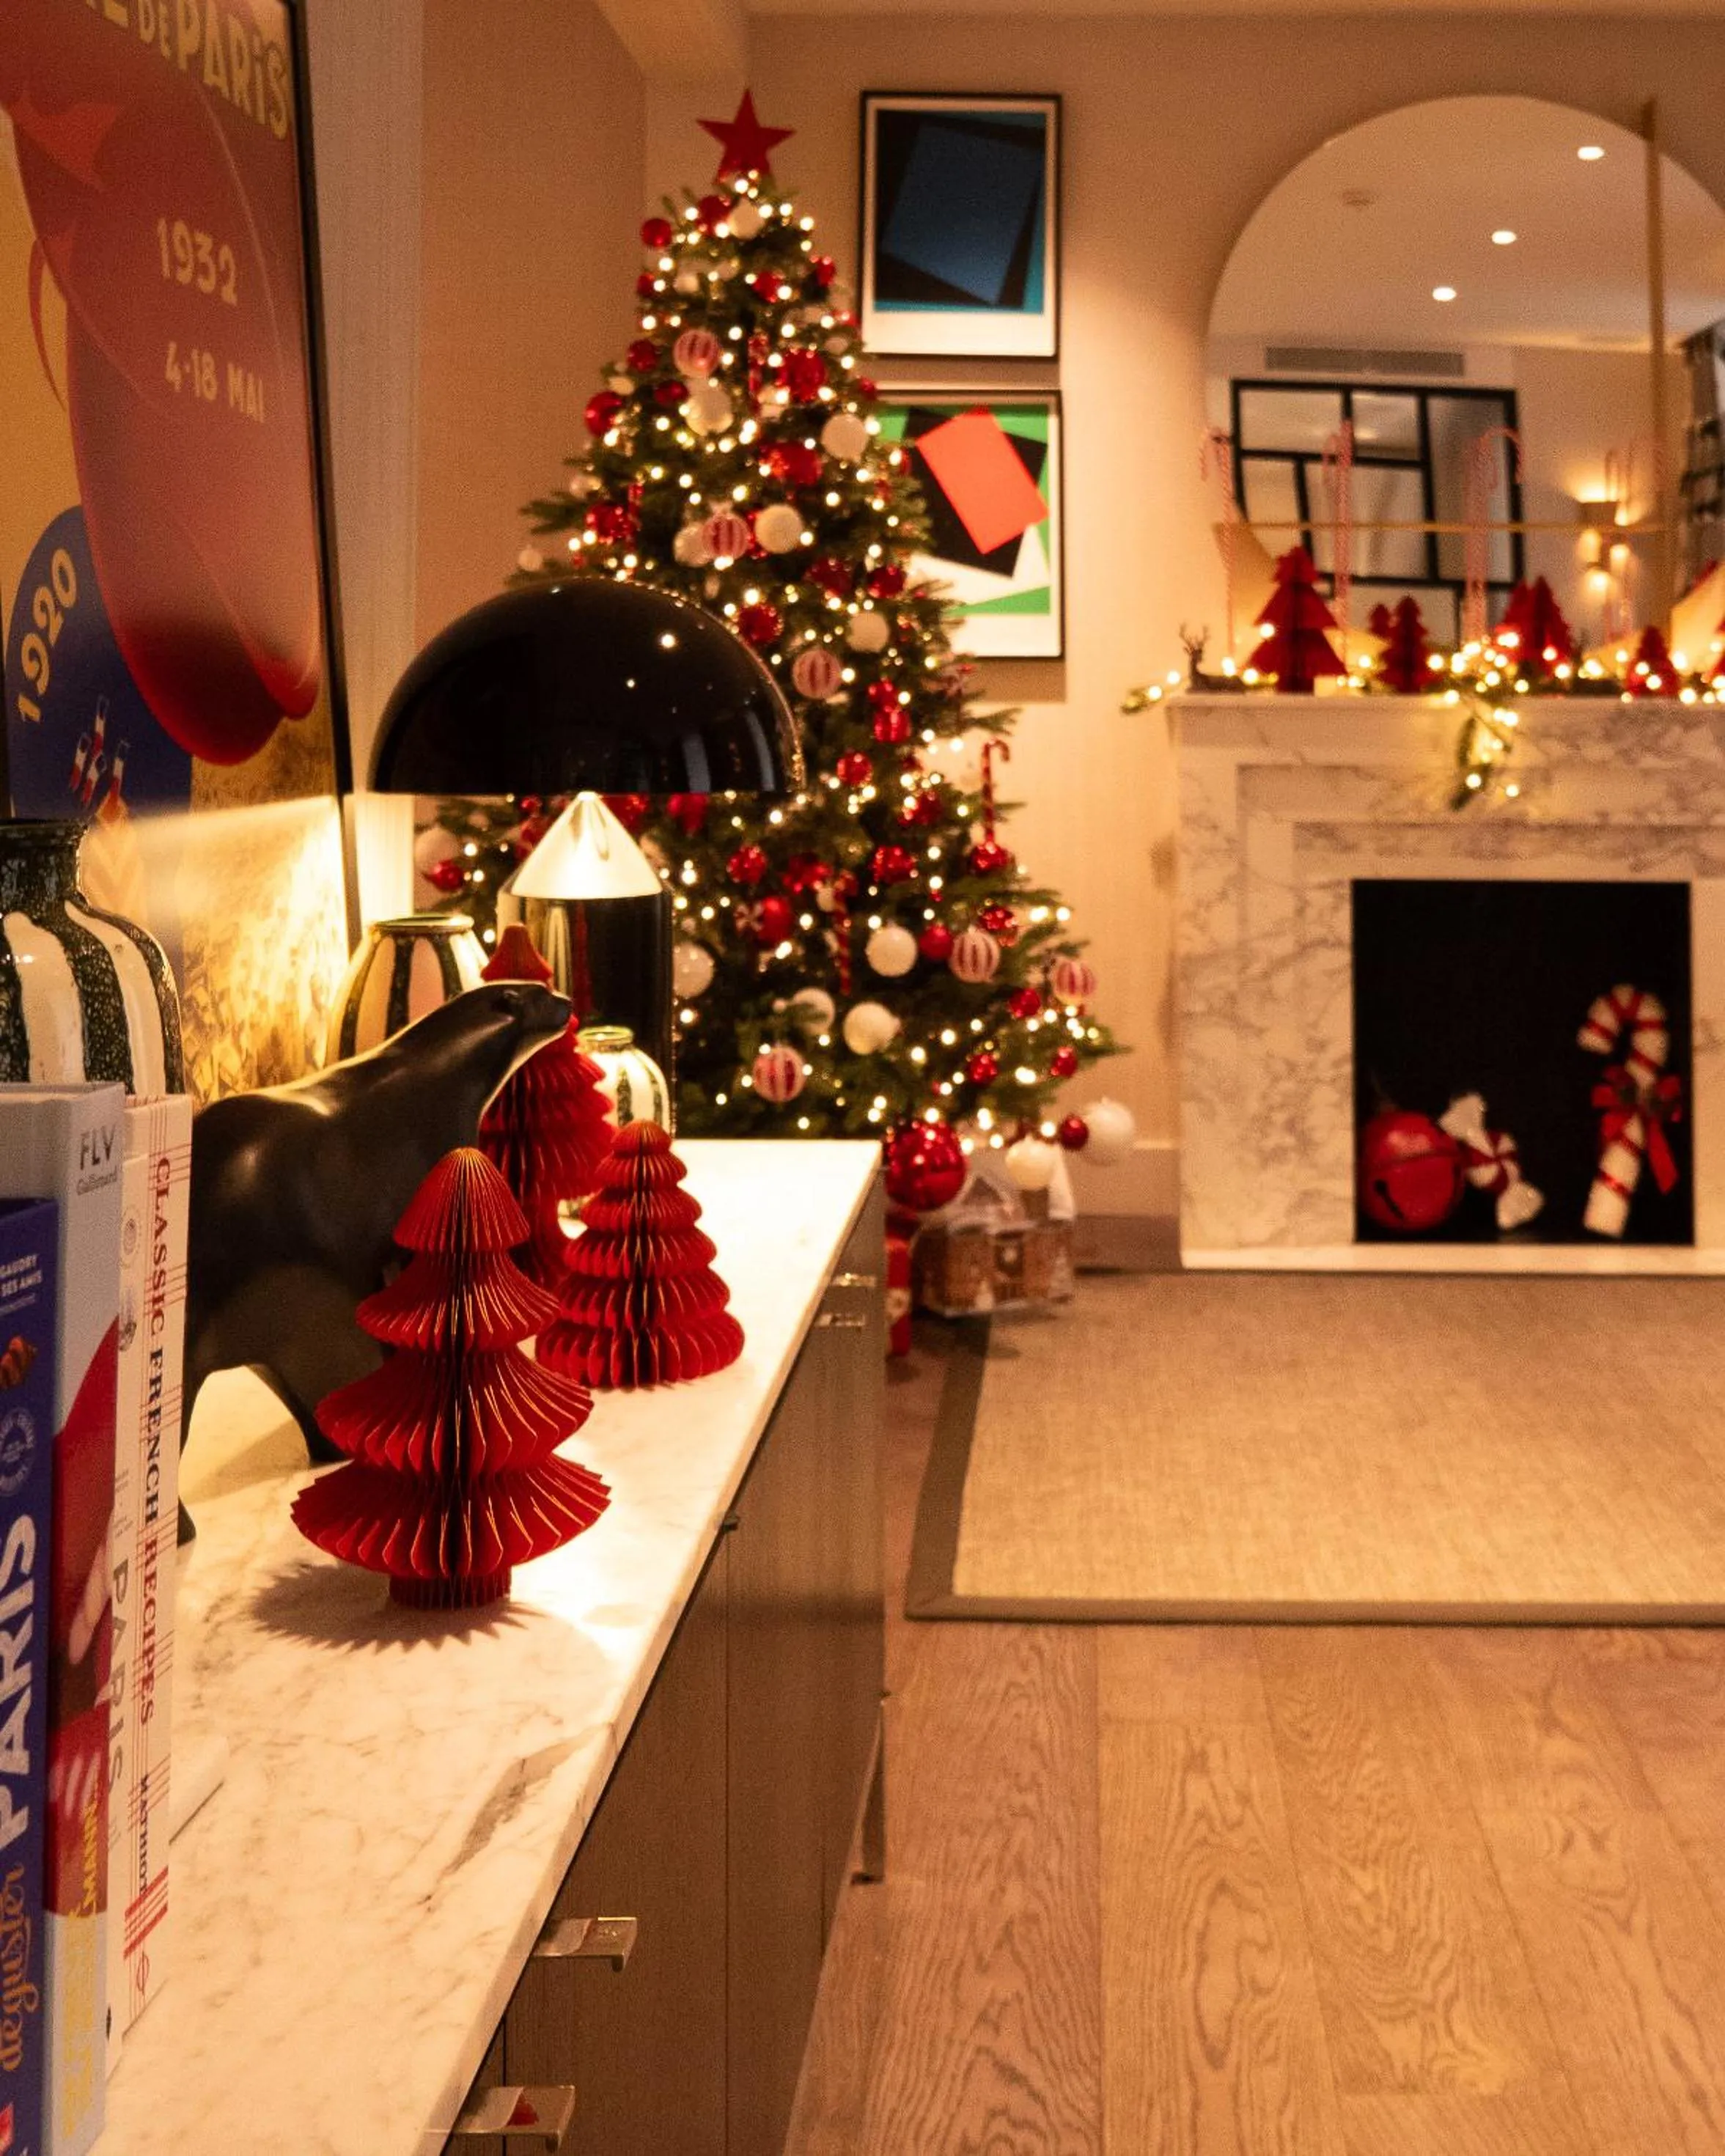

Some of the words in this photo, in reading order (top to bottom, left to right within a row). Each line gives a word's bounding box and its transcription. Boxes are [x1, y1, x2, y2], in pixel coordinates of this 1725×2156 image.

[158, 218, 237, 306] 1932
[17, 548, 76, 724] 1920
[149, 1157, 170, 1336] CLASSIC
[144, 1348, 163, 1524] FRENCH
[0, 1515, 36, 1851] PARIS
[108, 1559, 128, 1794] PARIS
[140, 1537, 158, 1726] RECIPES
